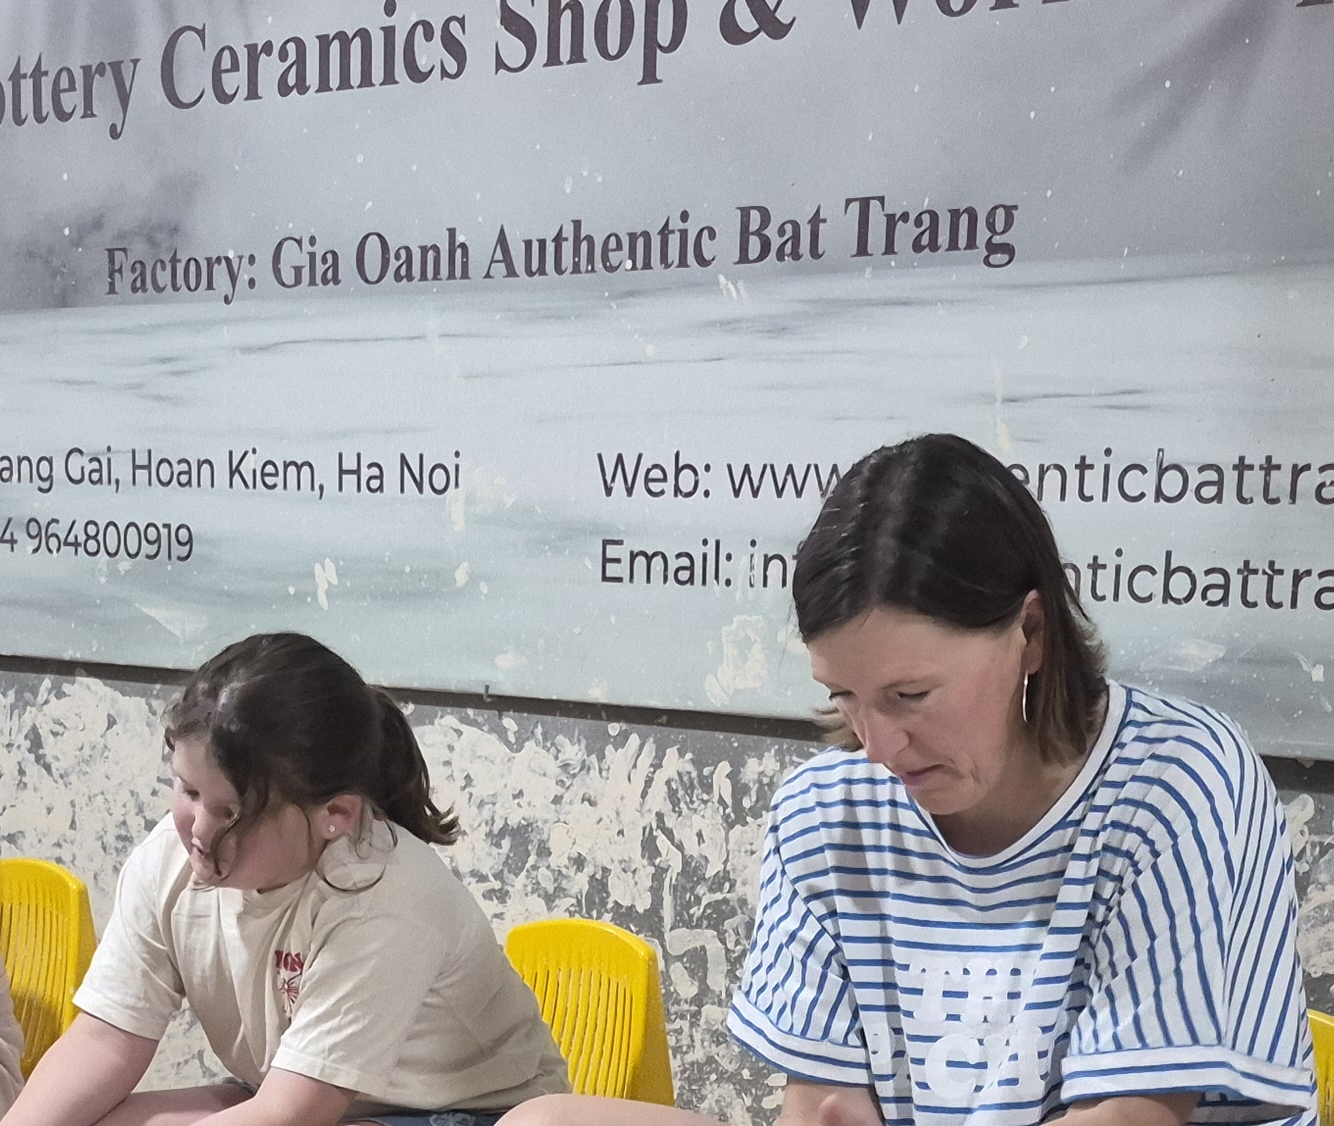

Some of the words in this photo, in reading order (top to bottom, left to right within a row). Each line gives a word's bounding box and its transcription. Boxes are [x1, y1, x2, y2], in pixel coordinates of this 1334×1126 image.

[161, 1, 467, 109] Ceramics
[494, 0, 688, 86] Shop
[105, 245, 257, 305] Factory:
[272, 235, 342, 289] Gia
[355, 227, 471, 286] Oanh
[482, 209, 717, 281] Authentic
[733, 204, 828, 266] Bat
[843, 195, 1019, 268] Trang
[64, 445, 120, 494] Gai,
[130, 448, 215, 489] Hoan
[227, 447, 325, 500] Kiem,
[337, 452, 385, 494] Ha
[399, 450, 461, 495] Noi
[596, 450, 712, 498] Web:
[25, 516, 194, 562] 964800919
[600, 537, 734, 588] Email:
